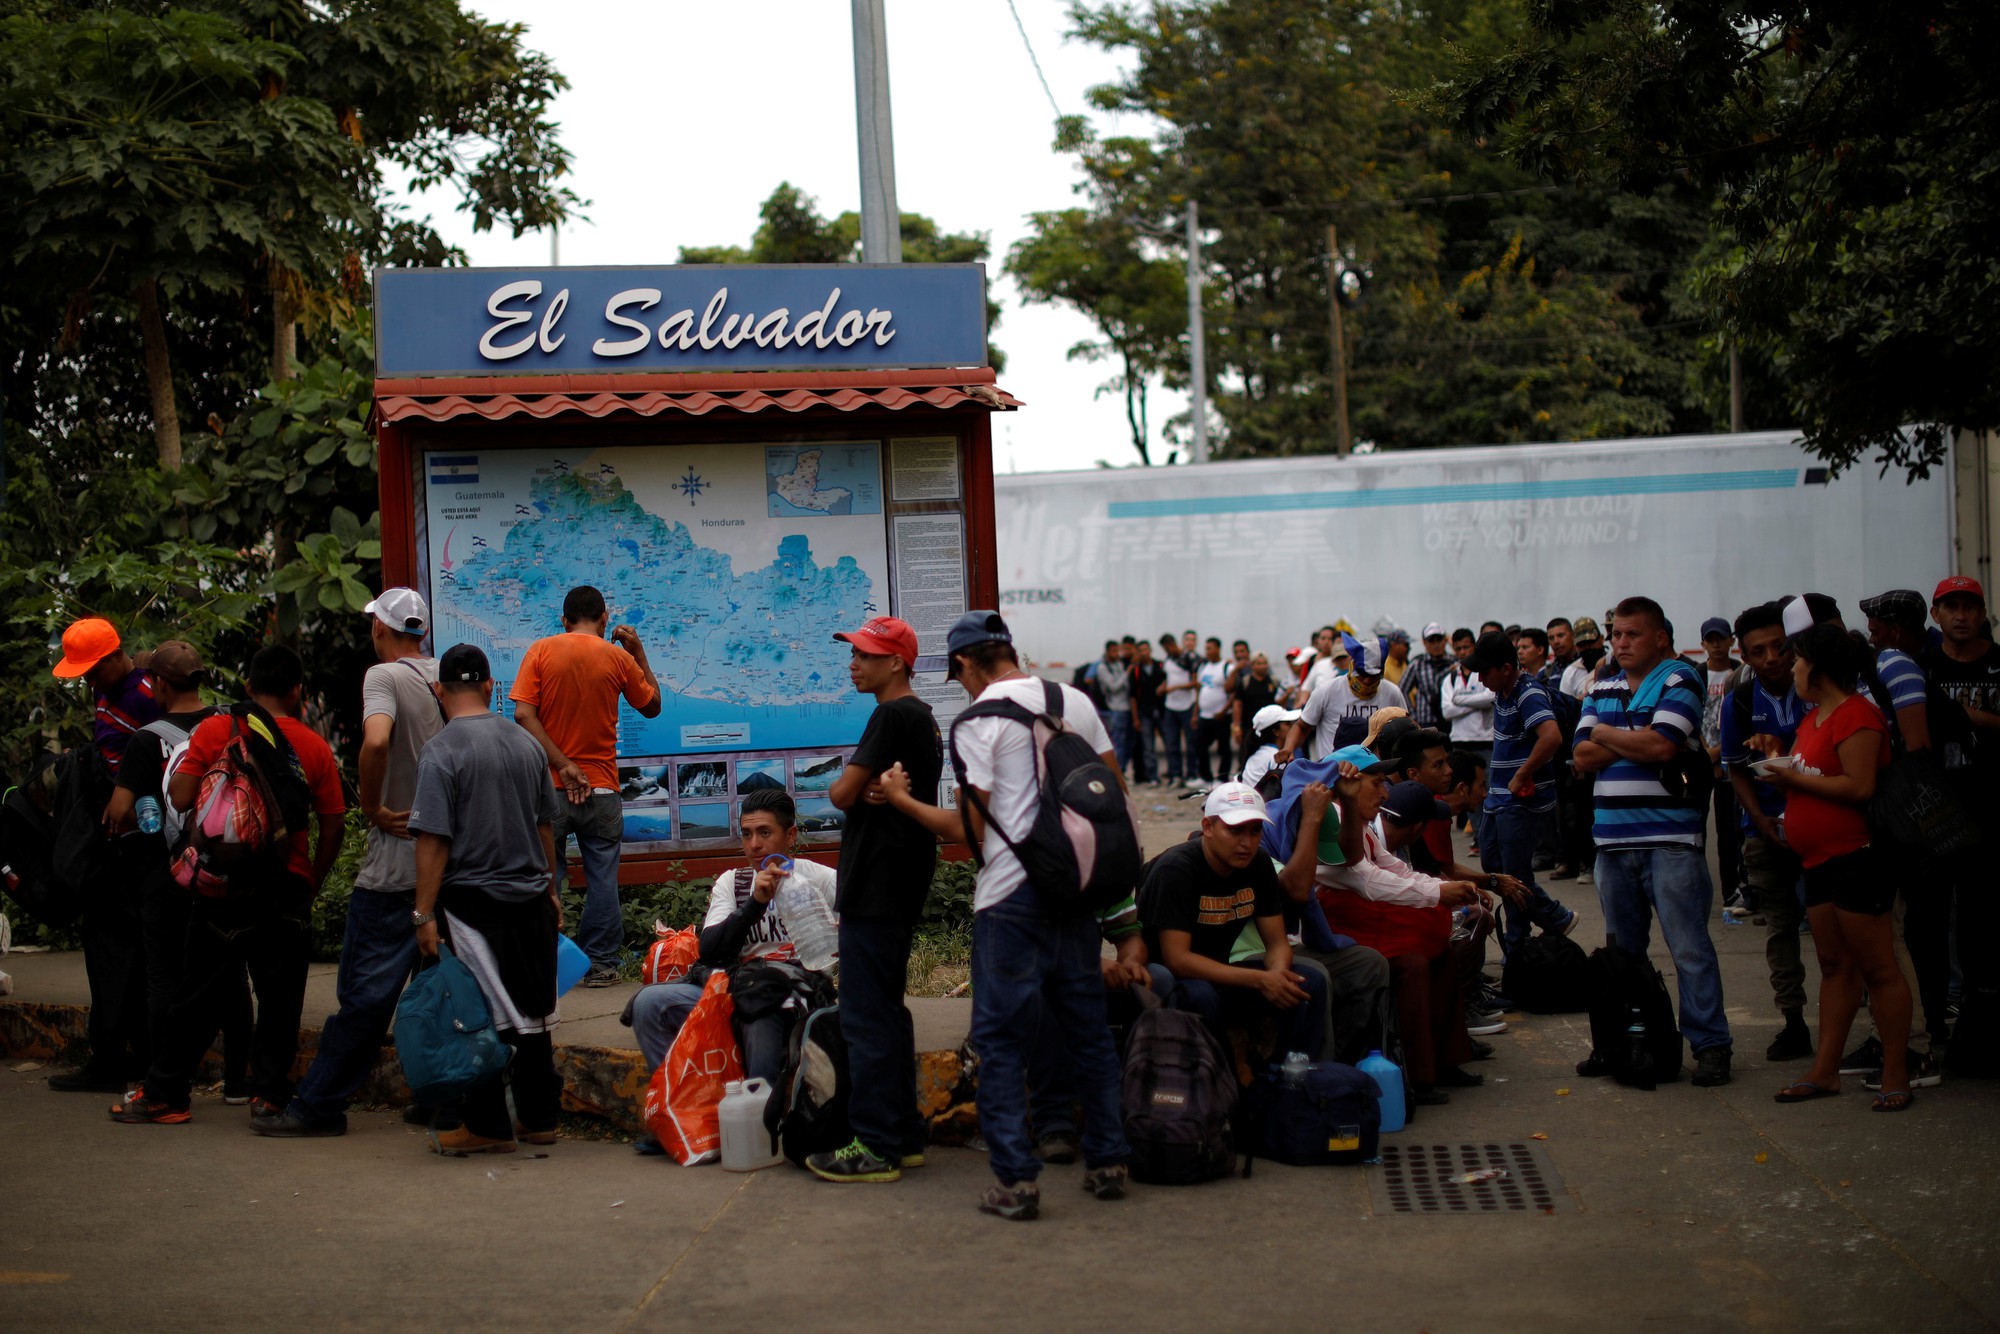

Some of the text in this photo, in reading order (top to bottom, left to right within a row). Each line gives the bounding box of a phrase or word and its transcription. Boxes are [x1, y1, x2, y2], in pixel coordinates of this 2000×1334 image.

[479, 280, 897, 360] El Salvador
[455, 490, 505, 501] Guatemala
[441, 506, 457, 514] USTED
[1423, 503, 1459, 523] WE
[1472, 499, 1530, 521] TAKE
[1563, 494, 1632, 516] LOAD
[444, 513, 453, 521] YOU
[464, 512, 478, 520] HERE
[701, 518, 745, 528] Honduras
[1424, 527, 1473, 551] OFF
[1481, 523, 1549, 549] YOUR
